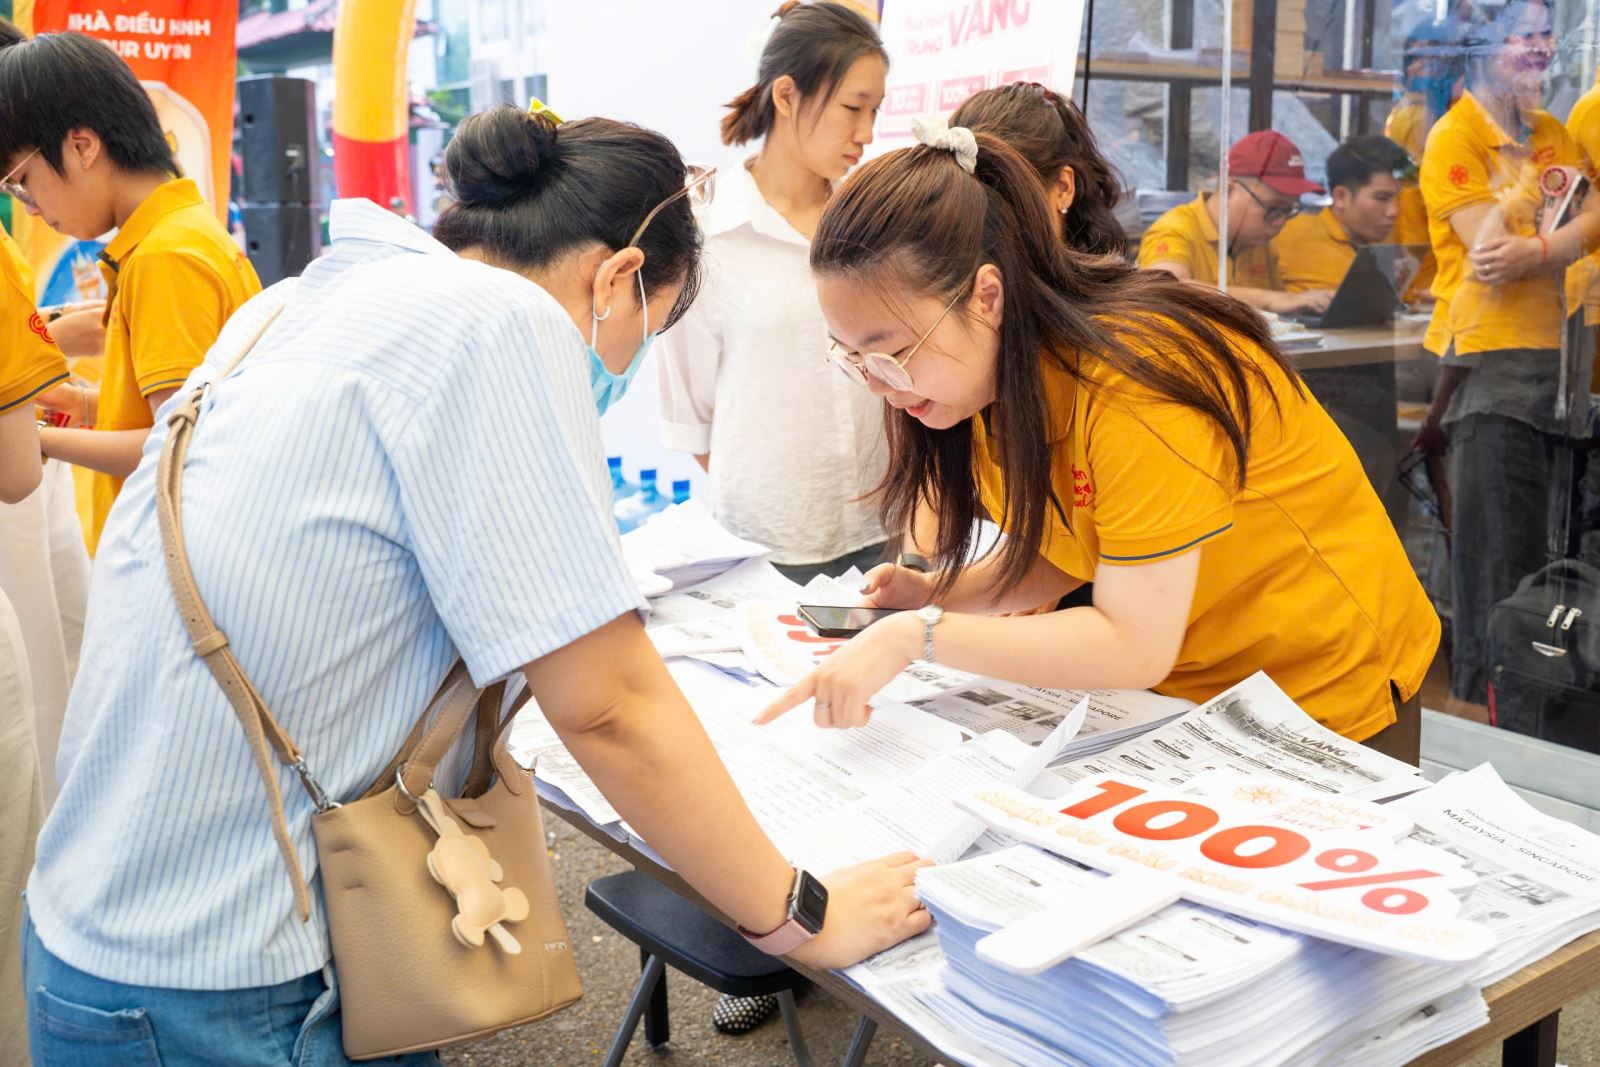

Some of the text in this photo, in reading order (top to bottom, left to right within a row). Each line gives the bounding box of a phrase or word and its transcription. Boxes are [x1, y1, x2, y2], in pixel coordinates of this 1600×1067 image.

[1058, 779, 1444, 915] 100%
[1443, 808, 1506, 845] MALAYSIA
[1516, 847, 1599, 883] SINGAPORE
